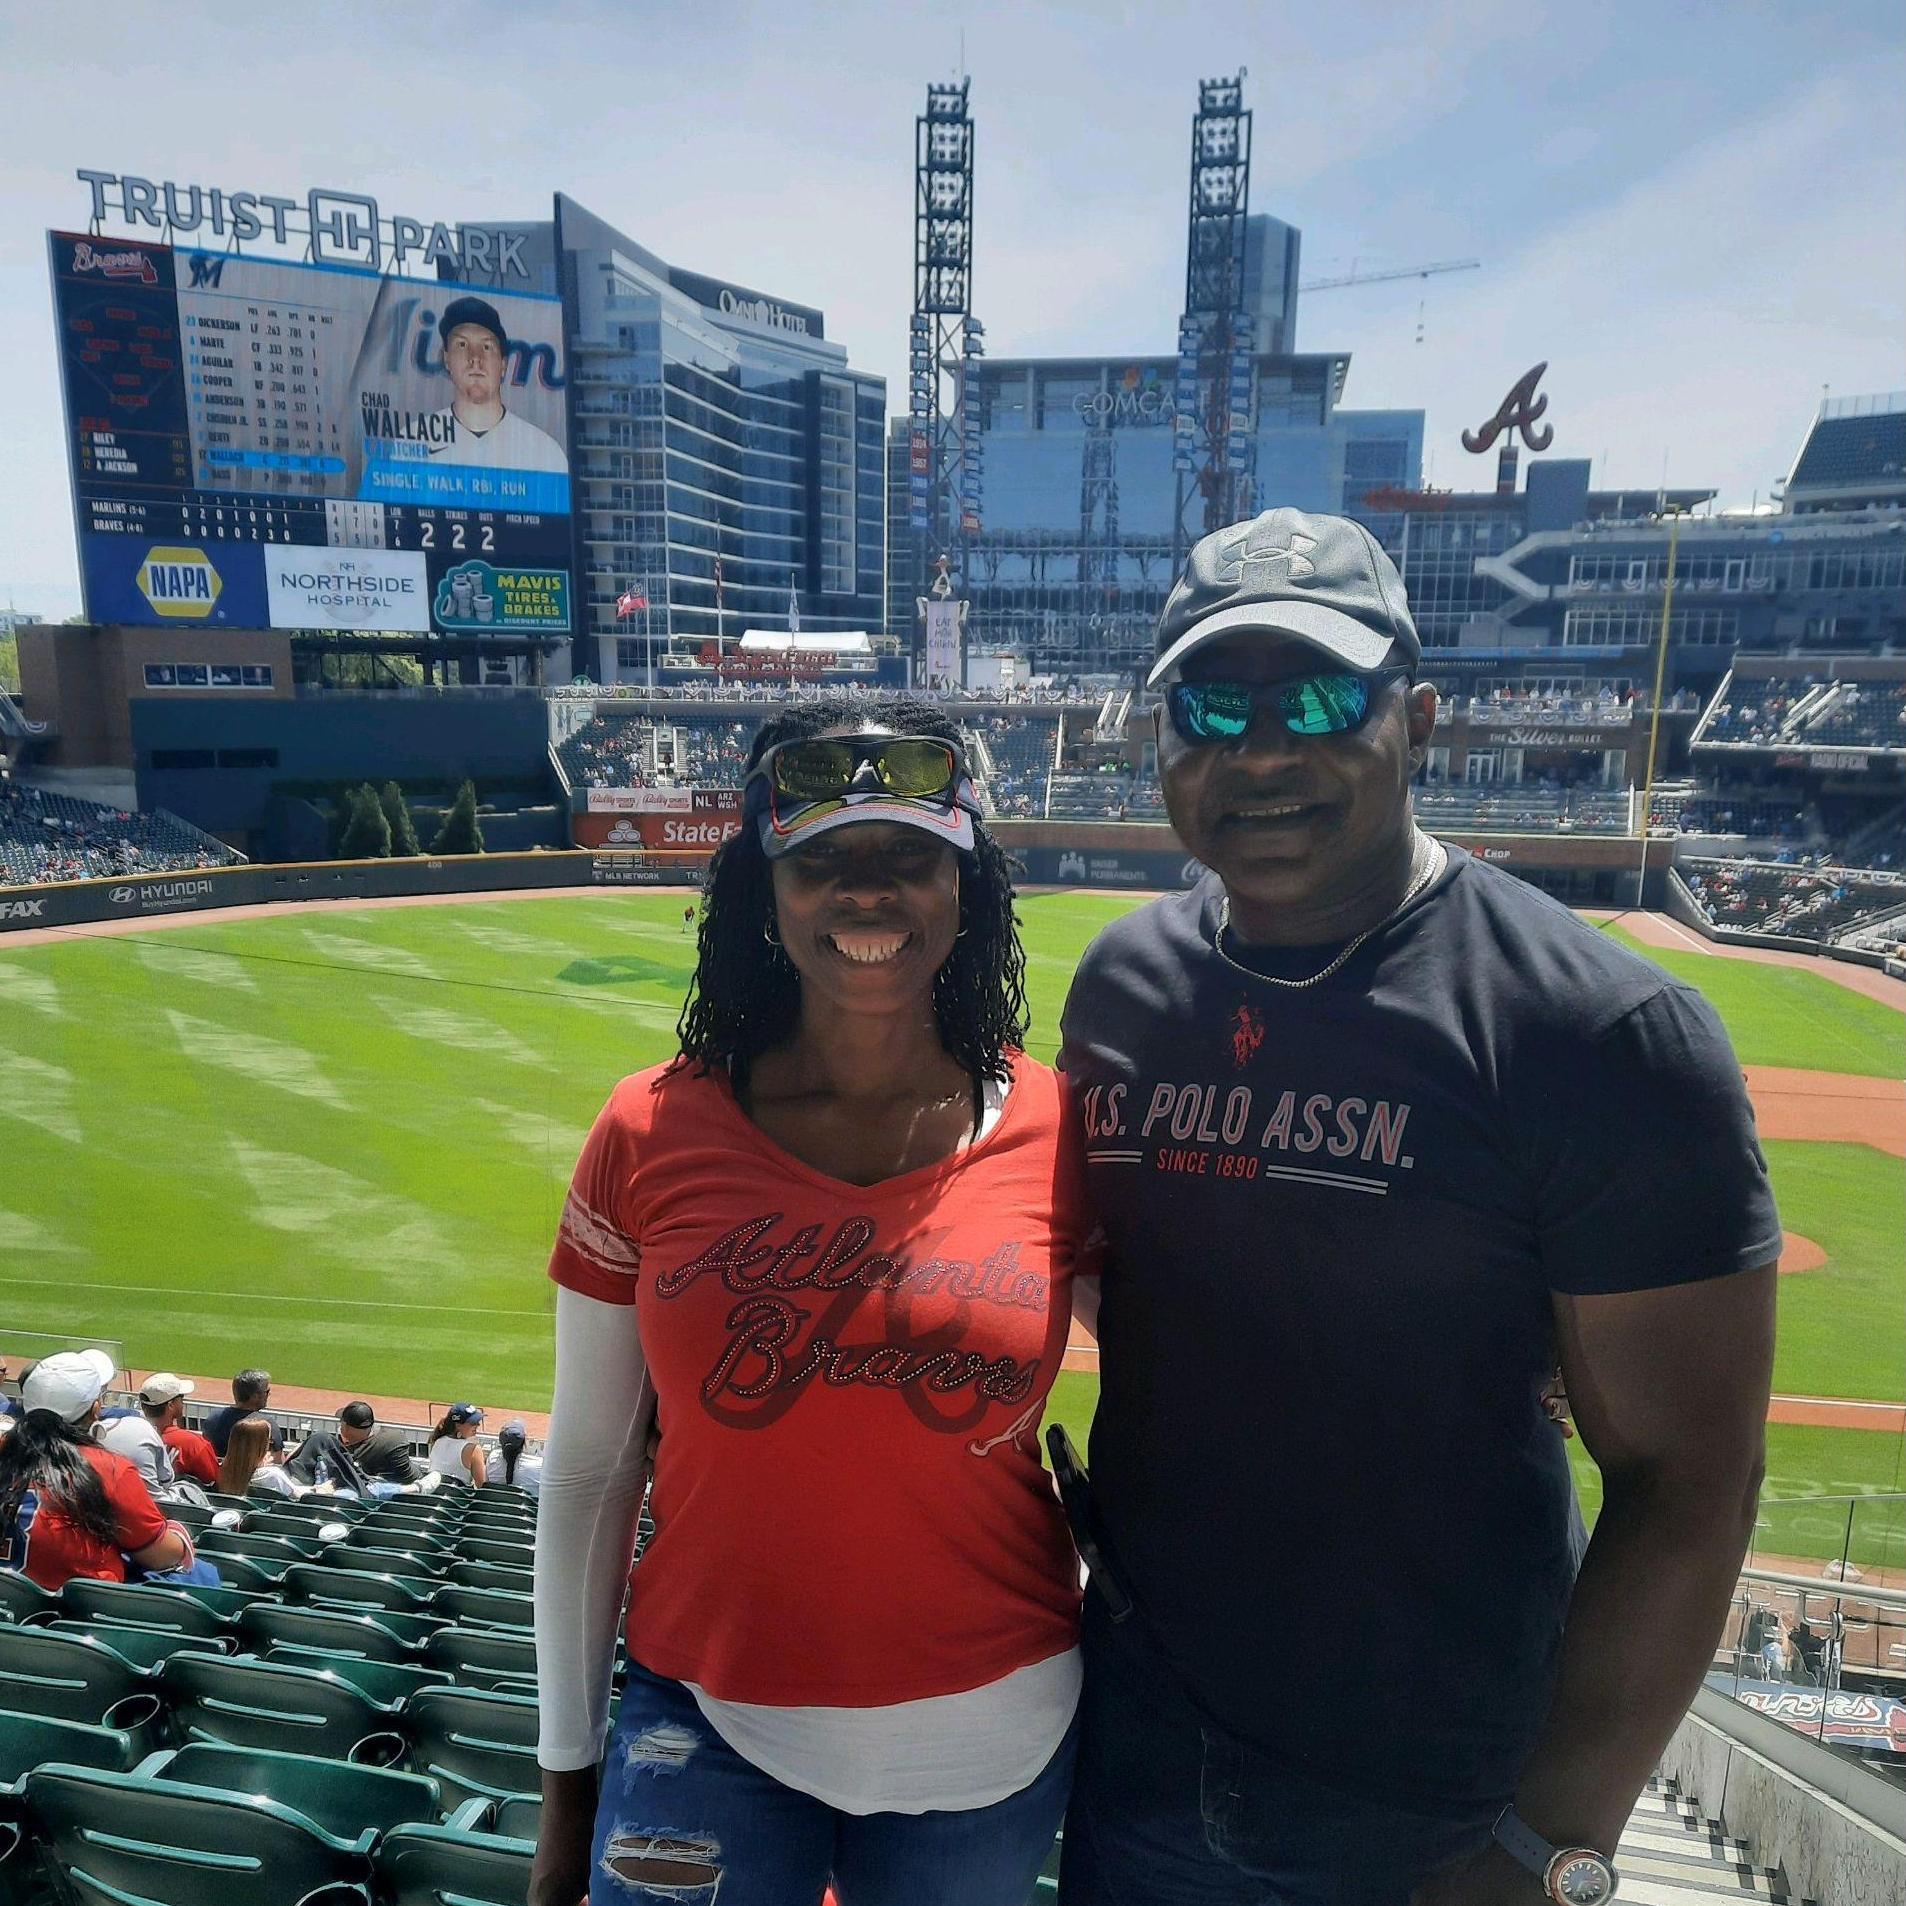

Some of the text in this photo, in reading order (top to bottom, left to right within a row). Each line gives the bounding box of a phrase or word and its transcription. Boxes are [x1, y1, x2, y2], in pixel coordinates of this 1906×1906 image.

[77, 169, 530, 279] TRUIST PARK
[198, 317, 241, 332] DICKERSON
[200, 337, 225, 350] MARTE
[201, 355, 234, 369] AGUILAR
[203, 374, 233, 388] COOPER
[204, 393, 244, 408] ANDERSON
[361, 391, 390, 408] CHAD
[1072, 391, 1210, 417] COMCAT
[361, 408, 456, 444] WALLACH
[501, 481, 527, 496] RUN
[91, 501, 126, 514] MARLINS
[182, 507, 189, 518] 0
[200, 508, 206, 519] 2
[217, 510, 223, 520] 0
[234, 511, 238, 521] 1
[250, 512, 256, 523] 0
[266, 513, 273, 524] 0
[284, 513, 288, 524] 1
[394, 519, 399, 531] 7
[93, 518, 124, 533] BRAVES
[184, 525, 190, 536] 0
[201, 526, 207, 537] 0
[218, 527, 224, 538] 0
[234, 528, 241, 539] 0
[252, 528, 258, 540] 2
[268, 529, 274, 541] 3
[284, 530, 290, 542] 0
[395, 536, 401, 547] 6
[421, 522, 495, 551] 2 2 2
[150, 565, 210, 599] NAPA
[281, 573, 415, 593] NORTHSIDE
[497, 574, 561, 591] MAVIS
[307, 594, 392, 607] HOSPITAL
[505, 591, 549, 604] TIRES
[504, 604, 560, 616] BRAKES
[1507, 726, 1565, 745] Silver
[695, 795, 713, 808] NL
[717, 792, 733, 801] ARZ
[717, 801, 738, 809] WSH
[663, 820, 718, 843] State
[623, 872, 660, 881] NETWORK
[141, 879, 213, 900] HYUNDAI
[0, 899, 47, 920] FAX
[1141, 1083, 1252, 1145] POLO
[1261, 1090, 1415, 1169] ASSN.
[1156, 1148, 1259, 1180] SINCE 1890
[655, 1212, 1051, 1311] Atlanta
[701, 1294, 1042, 1404] Braves
